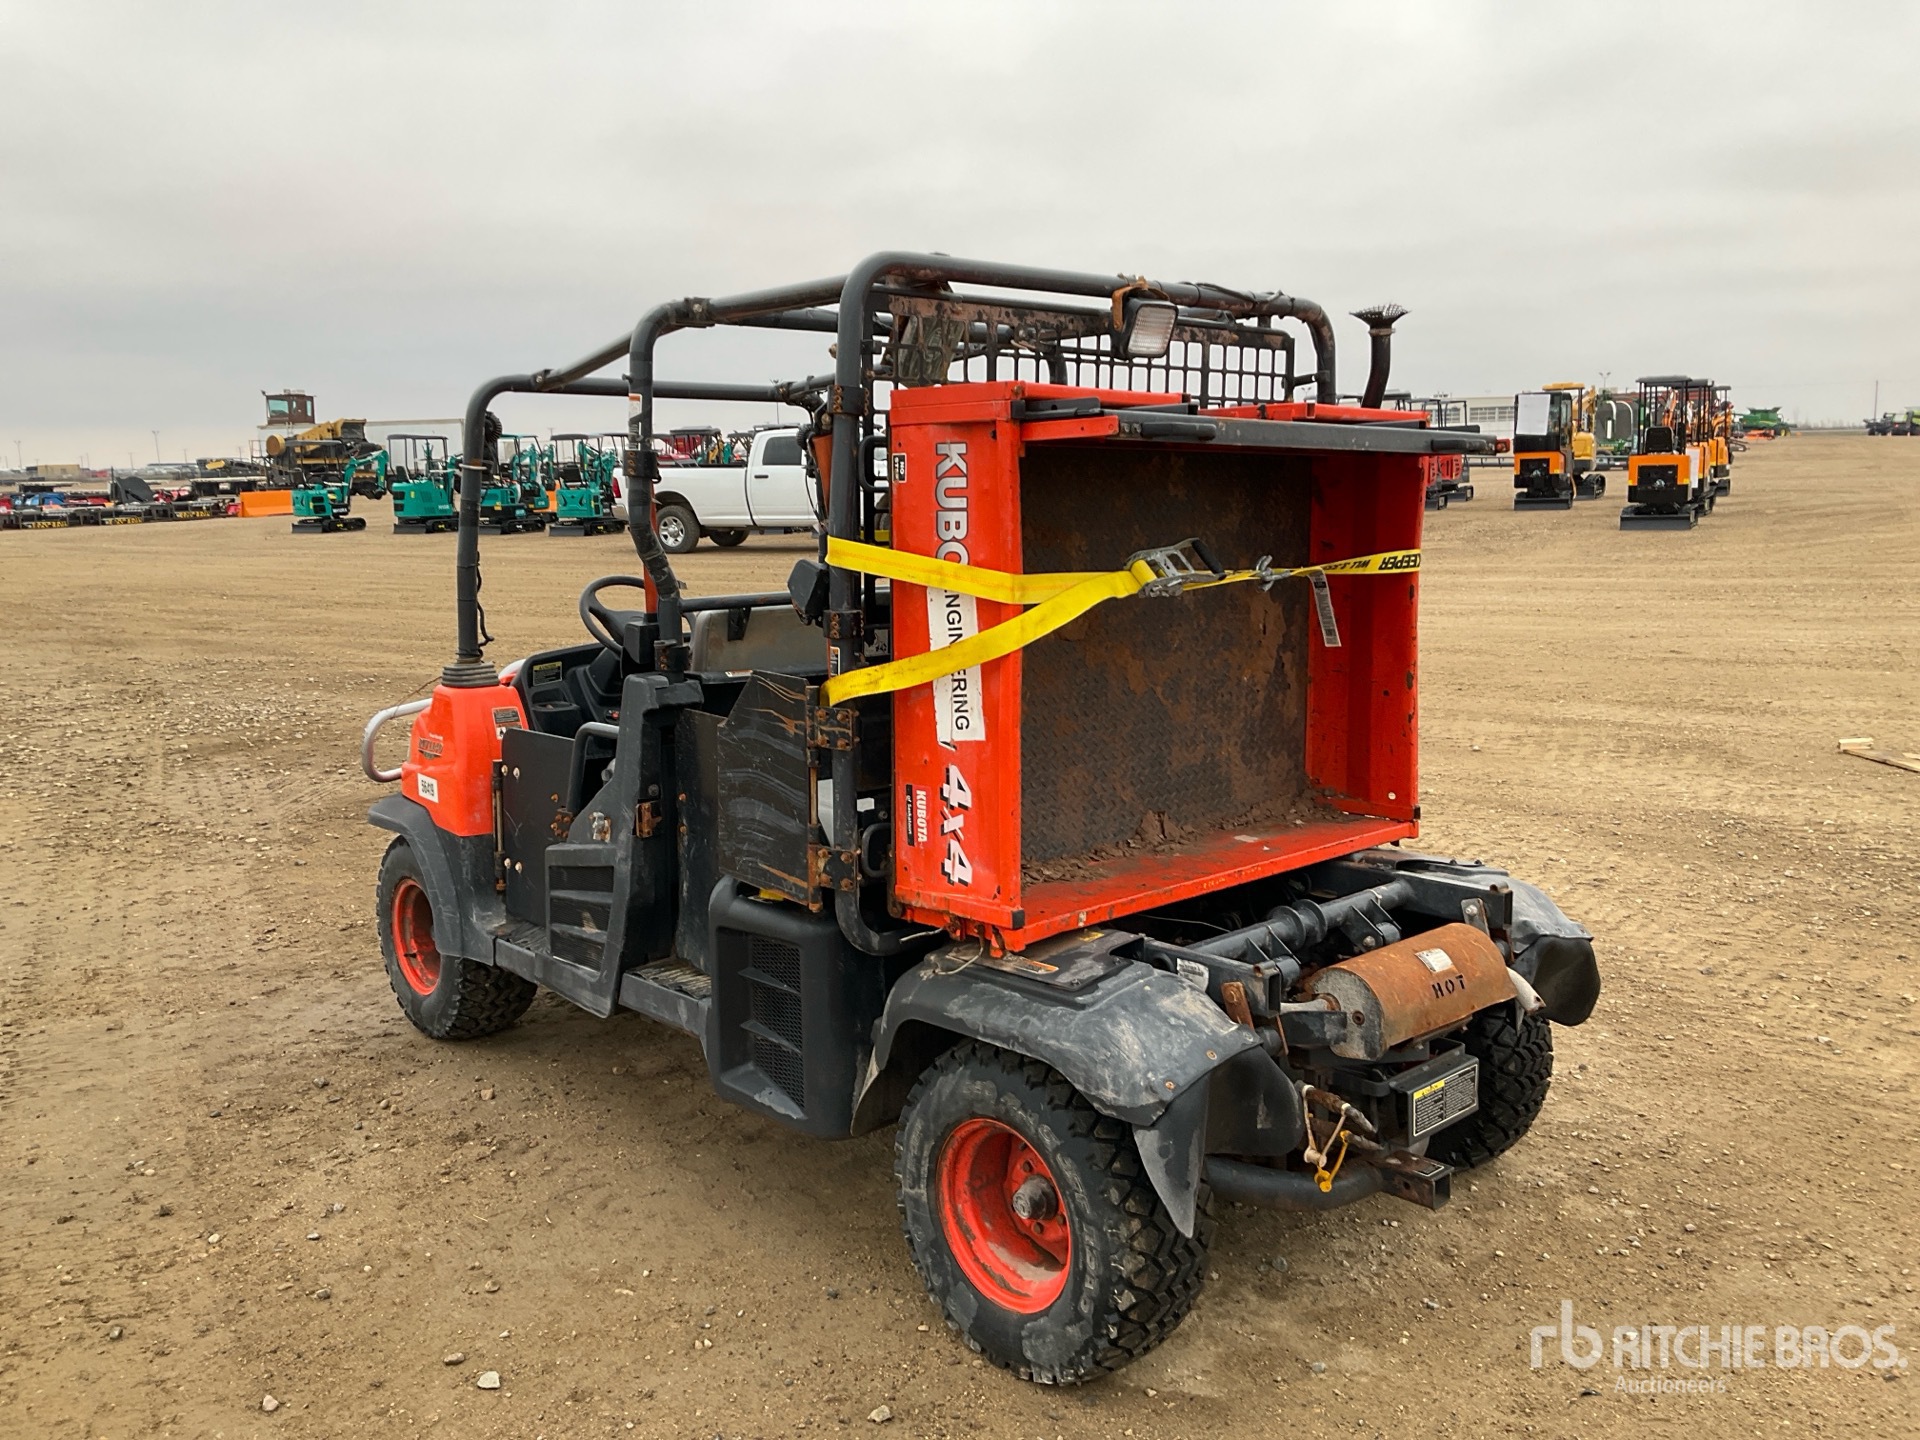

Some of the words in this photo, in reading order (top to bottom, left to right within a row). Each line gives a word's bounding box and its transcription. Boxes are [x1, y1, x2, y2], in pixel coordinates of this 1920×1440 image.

[900, 461, 905, 475] NO
[916, 789, 928, 843] KUBOTA
[1431, 974, 1465, 999] HOT
